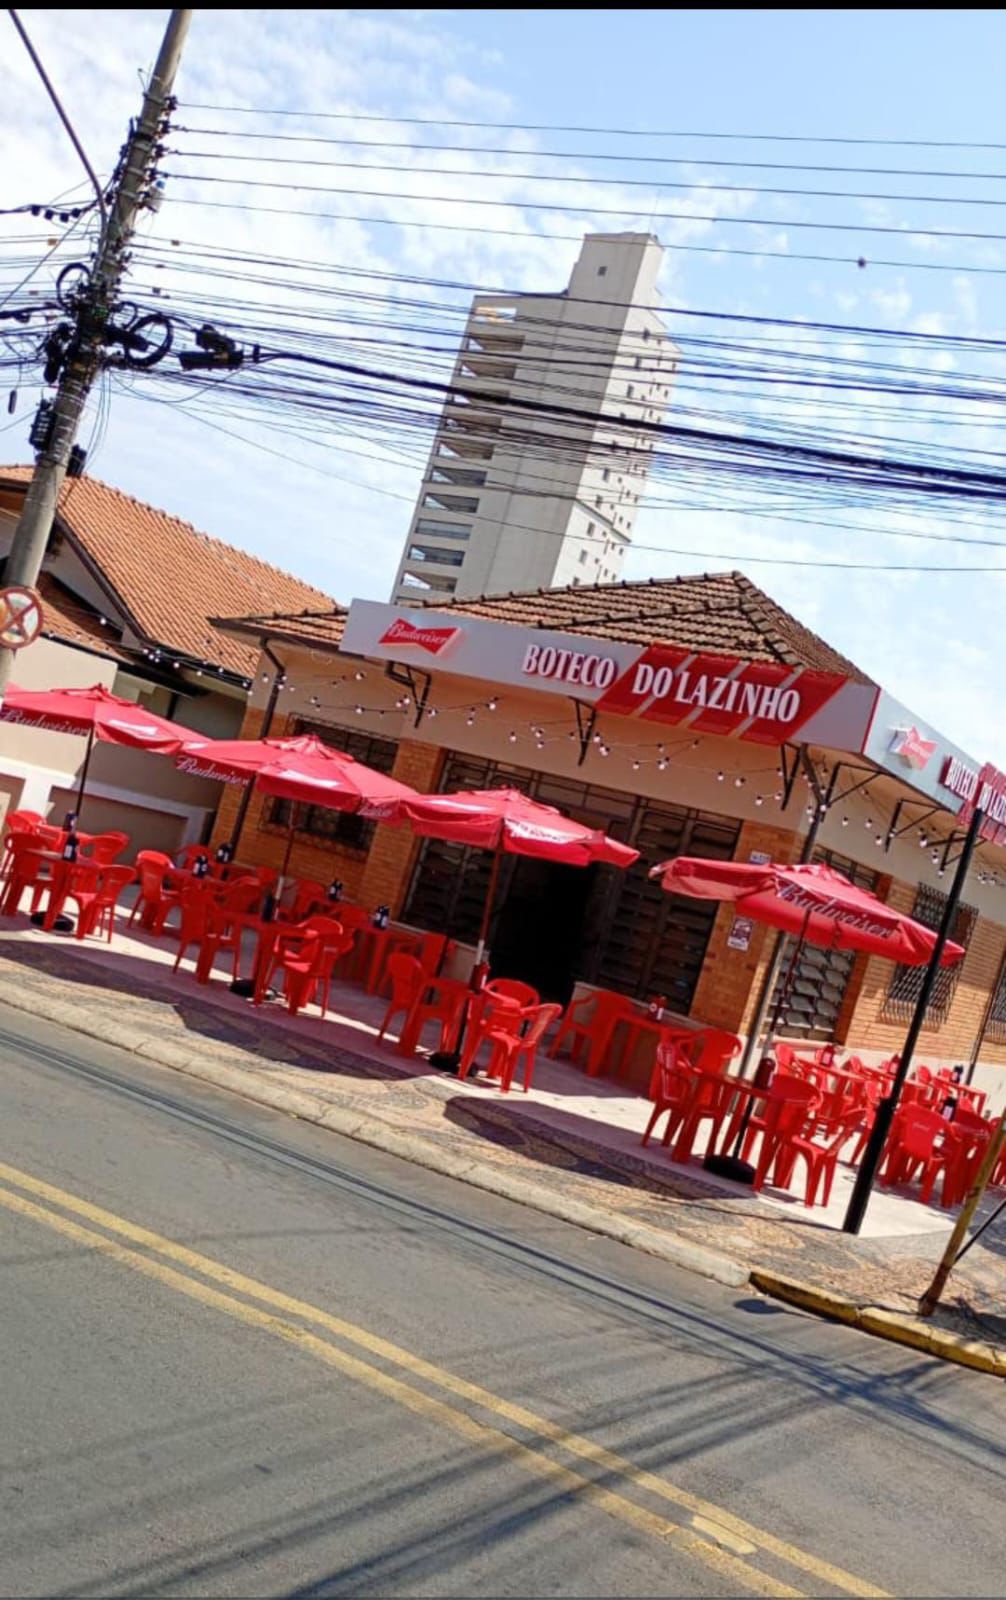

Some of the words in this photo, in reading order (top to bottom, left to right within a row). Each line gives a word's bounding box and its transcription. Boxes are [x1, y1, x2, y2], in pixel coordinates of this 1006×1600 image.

[386, 622, 450, 646] Budweiser
[521, 644, 617, 690] BOTECO
[631, 663, 674, 699] DO
[674, 671, 801, 723] LAZINHO
[778, 882, 894, 938] Budweiser
